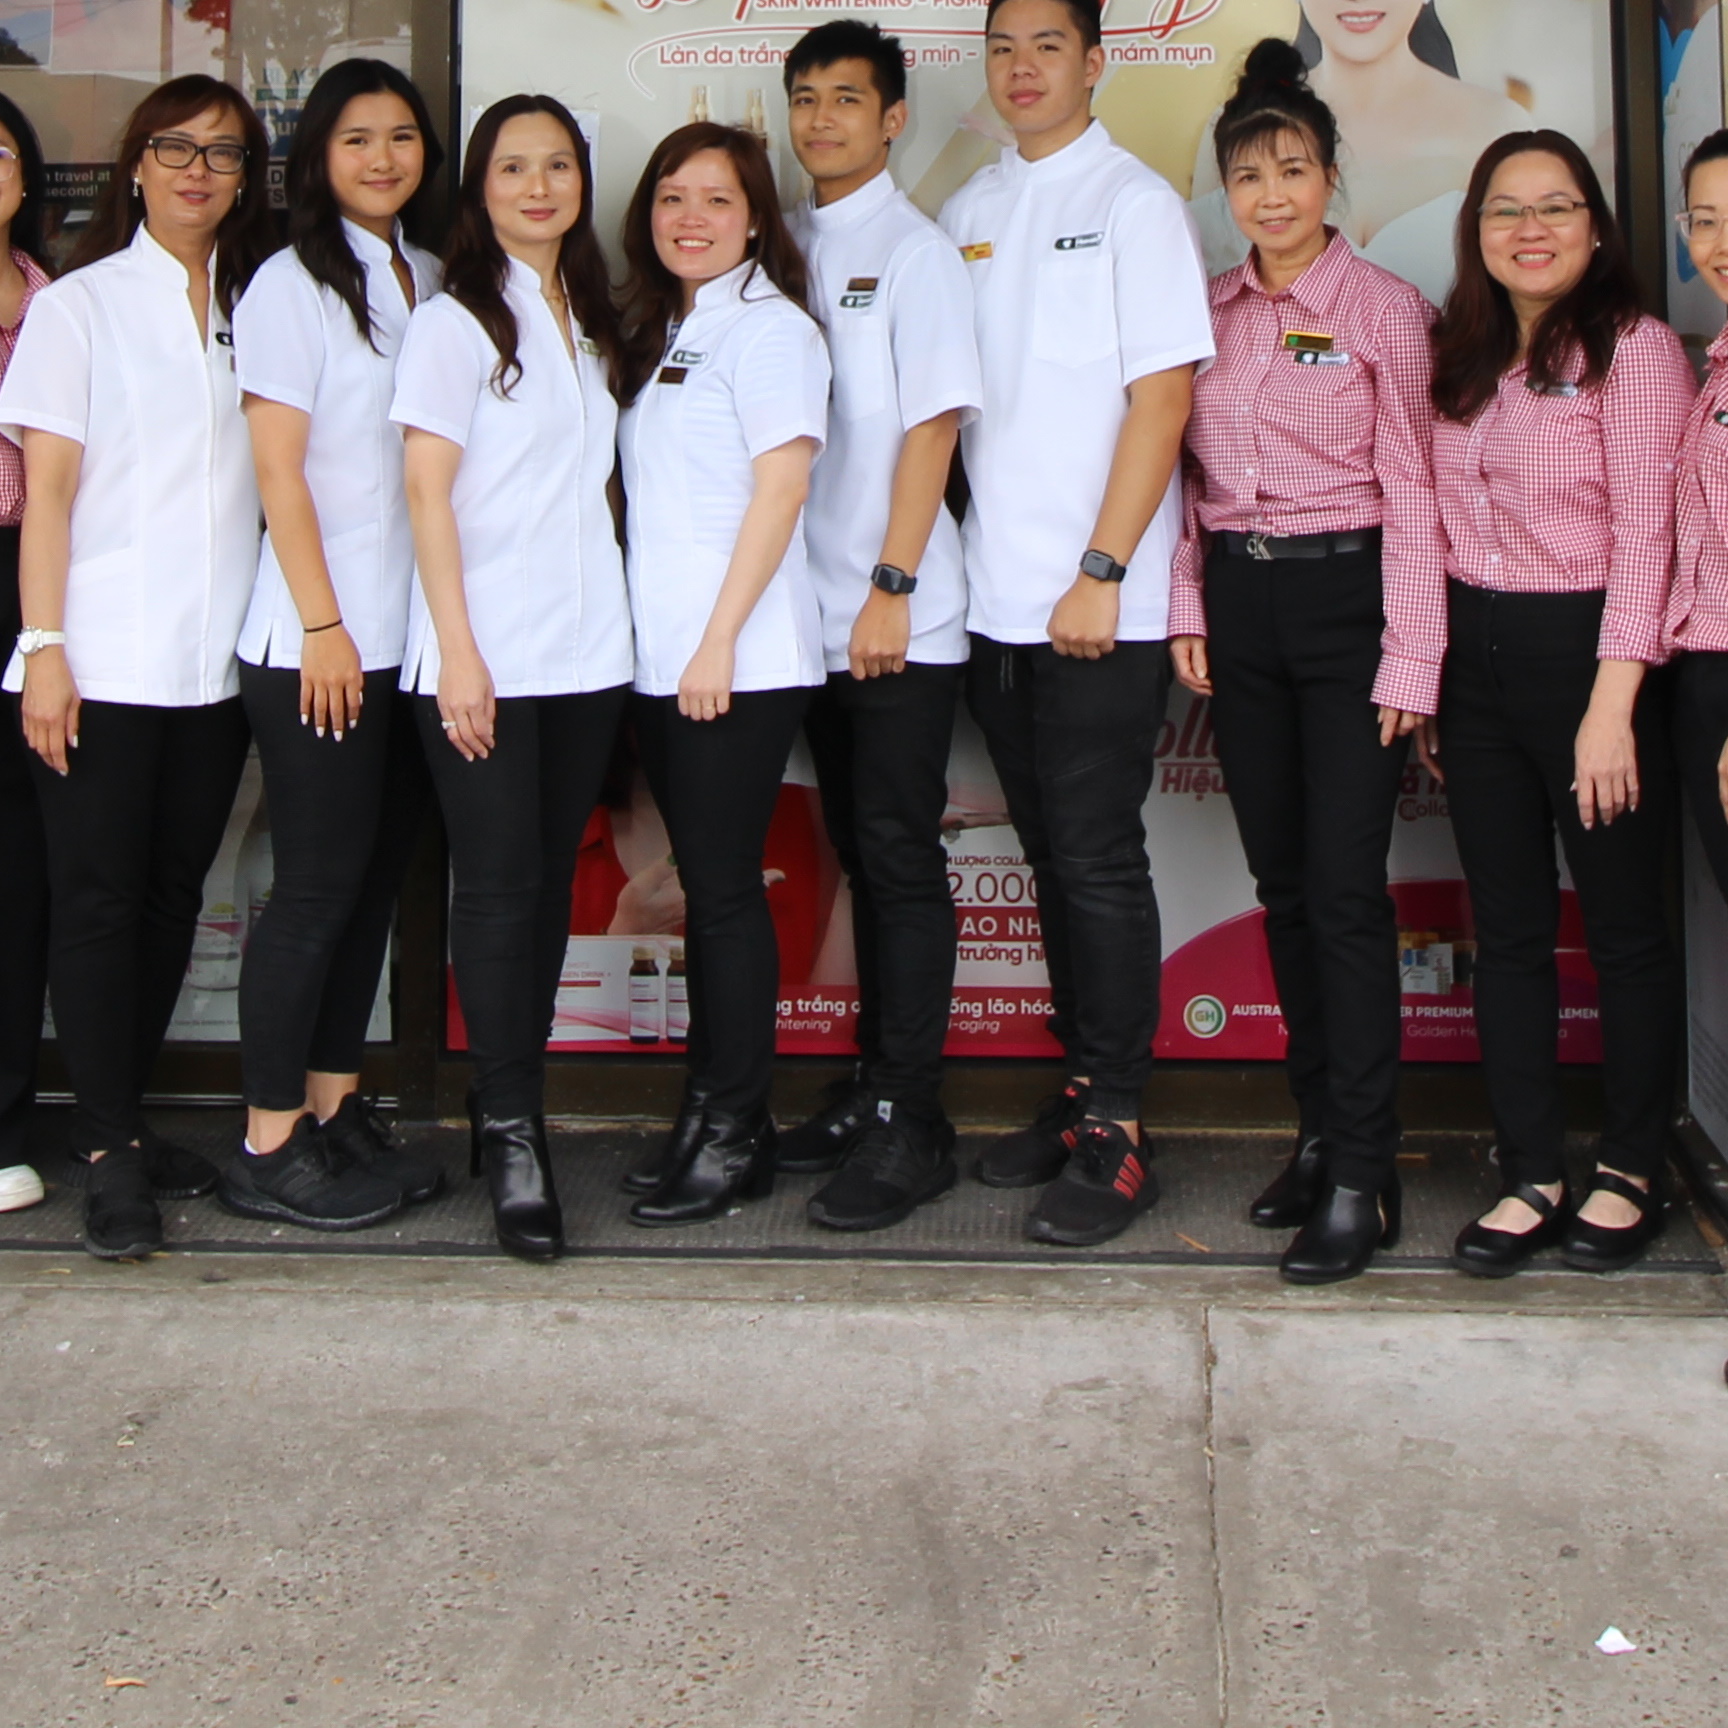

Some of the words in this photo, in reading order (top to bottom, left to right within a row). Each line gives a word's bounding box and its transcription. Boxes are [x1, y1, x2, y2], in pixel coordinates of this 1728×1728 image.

[659, 43, 699, 64] Làn
[703, 44, 733, 64] da
[922, 45, 961, 68] mịn
[1110, 43, 1157, 63] nám
[1161, 46, 1212, 68] mụn
[54, 171, 89, 183] travel
[958, 943, 1022, 966] trường
[796, 994, 847, 1017] trắng
[987, 997, 1017, 1015] lão
[1415, 1006, 1474, 1019] PREMIUM
[1406, 1023, 1454, 1038] Golden
